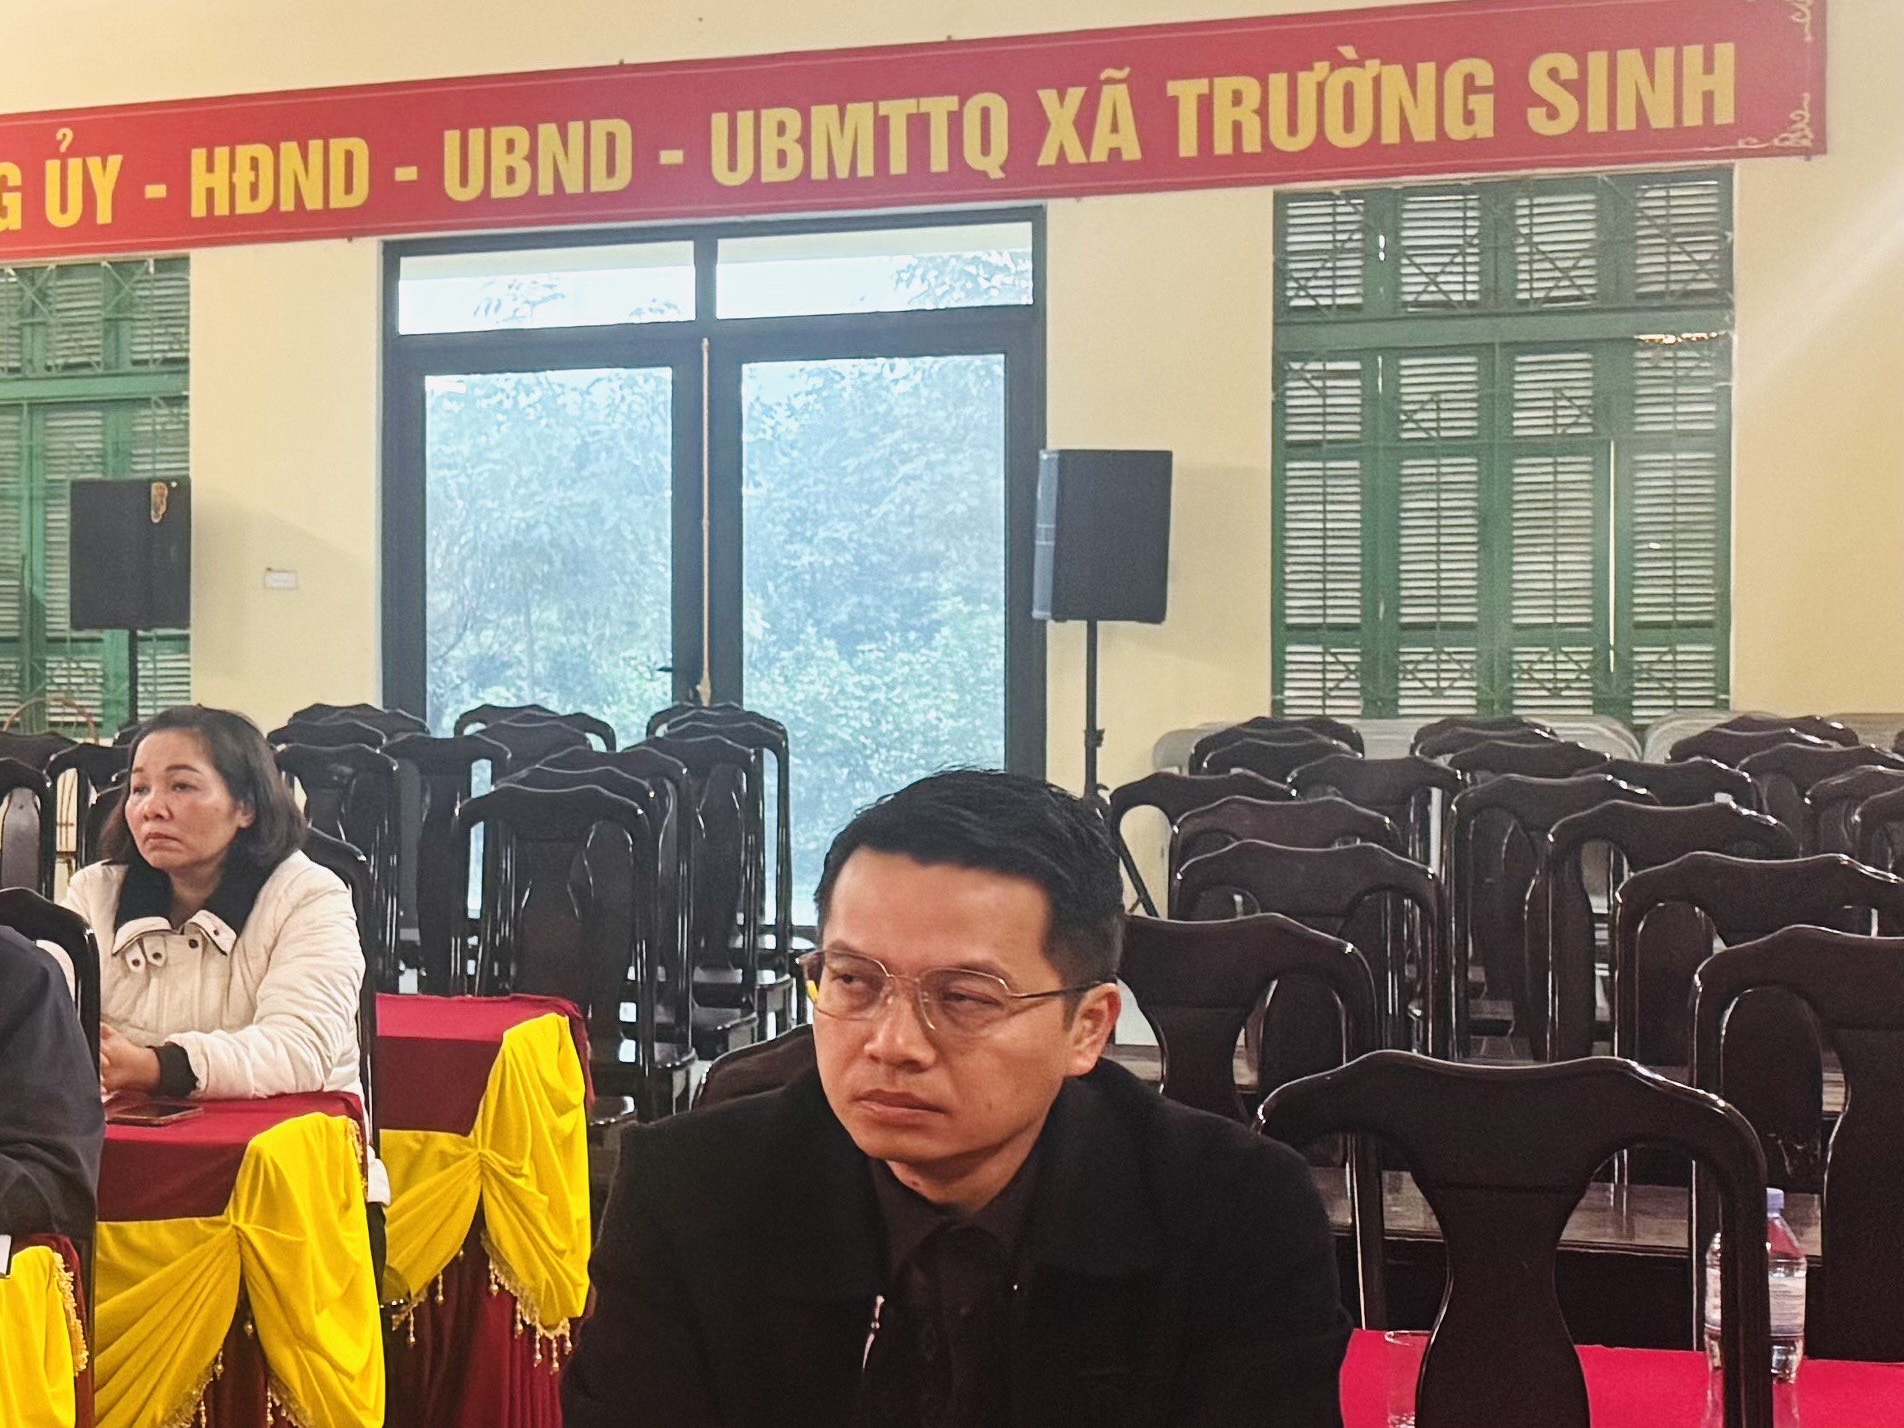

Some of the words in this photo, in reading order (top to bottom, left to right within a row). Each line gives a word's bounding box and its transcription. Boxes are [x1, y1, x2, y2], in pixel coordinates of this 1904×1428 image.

[44, 127, 123, 227] ỦY
[190, 136, 371, 218] HĐND
[442, 117, 633, 202] UBND
[710, 86, 1010, 186] UBMTTQ
[1036, 66, 1141, 166] XÃ
[1166, 44, 1496, 157] TRƯỜNG
[1527, 41, 1737, 136] SINH
